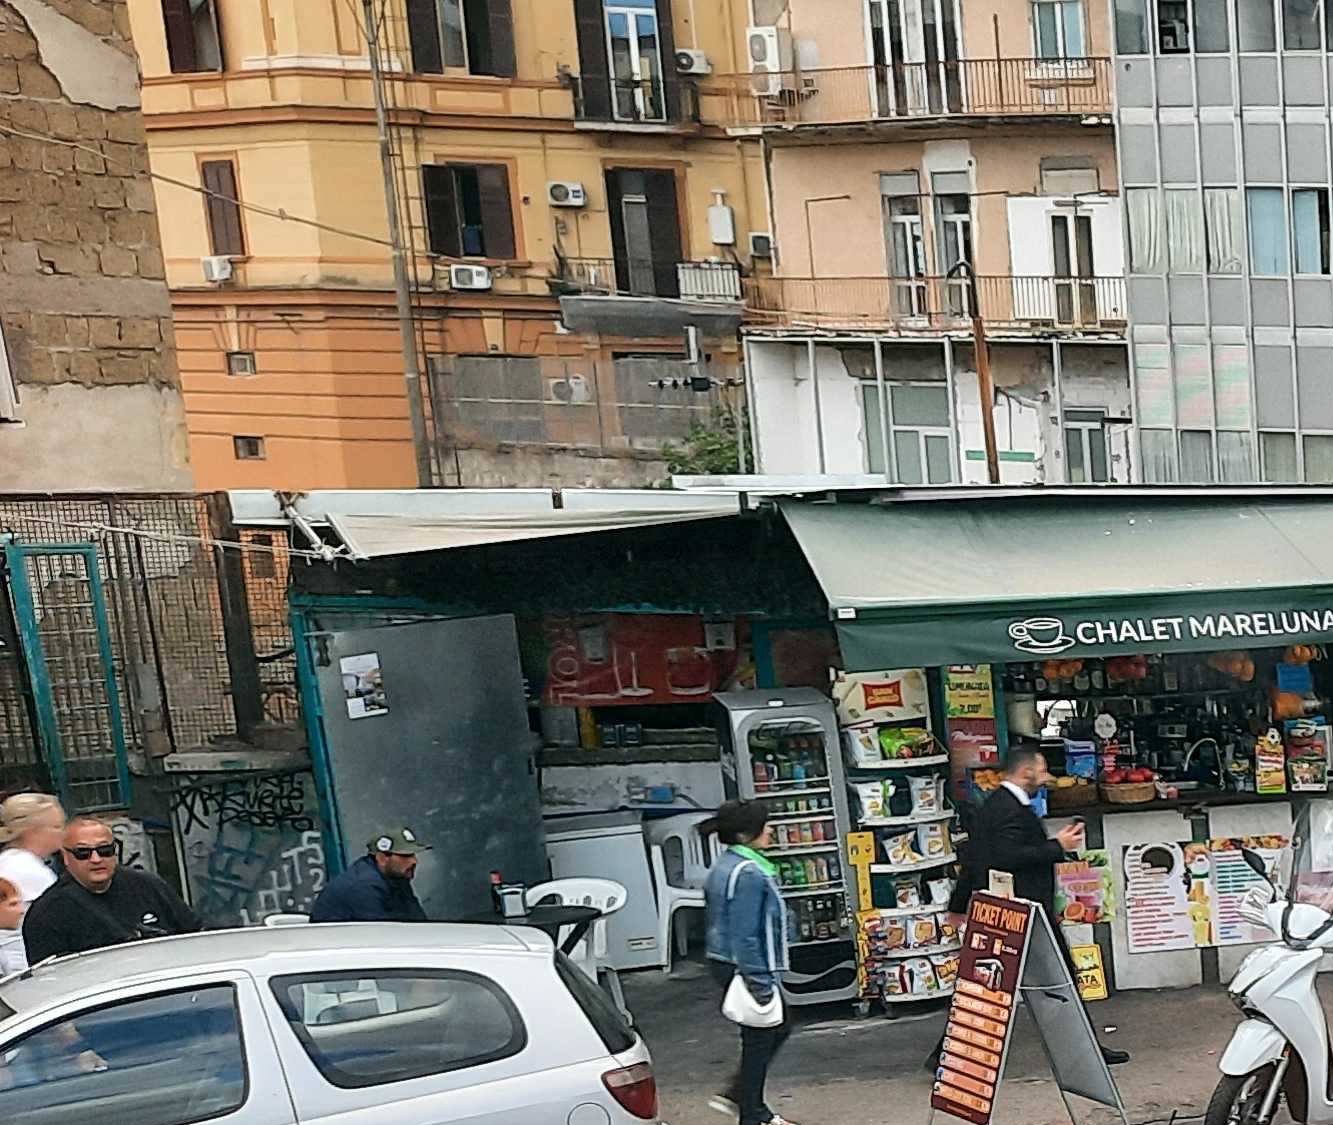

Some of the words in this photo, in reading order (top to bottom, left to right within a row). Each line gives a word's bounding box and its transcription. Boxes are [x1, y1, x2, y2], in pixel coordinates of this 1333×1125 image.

[1076, 617, 1184, 644] CHALET
[970, 900, 1000, 929] TICKET
[1000, 907, 1028, 934] POINT
